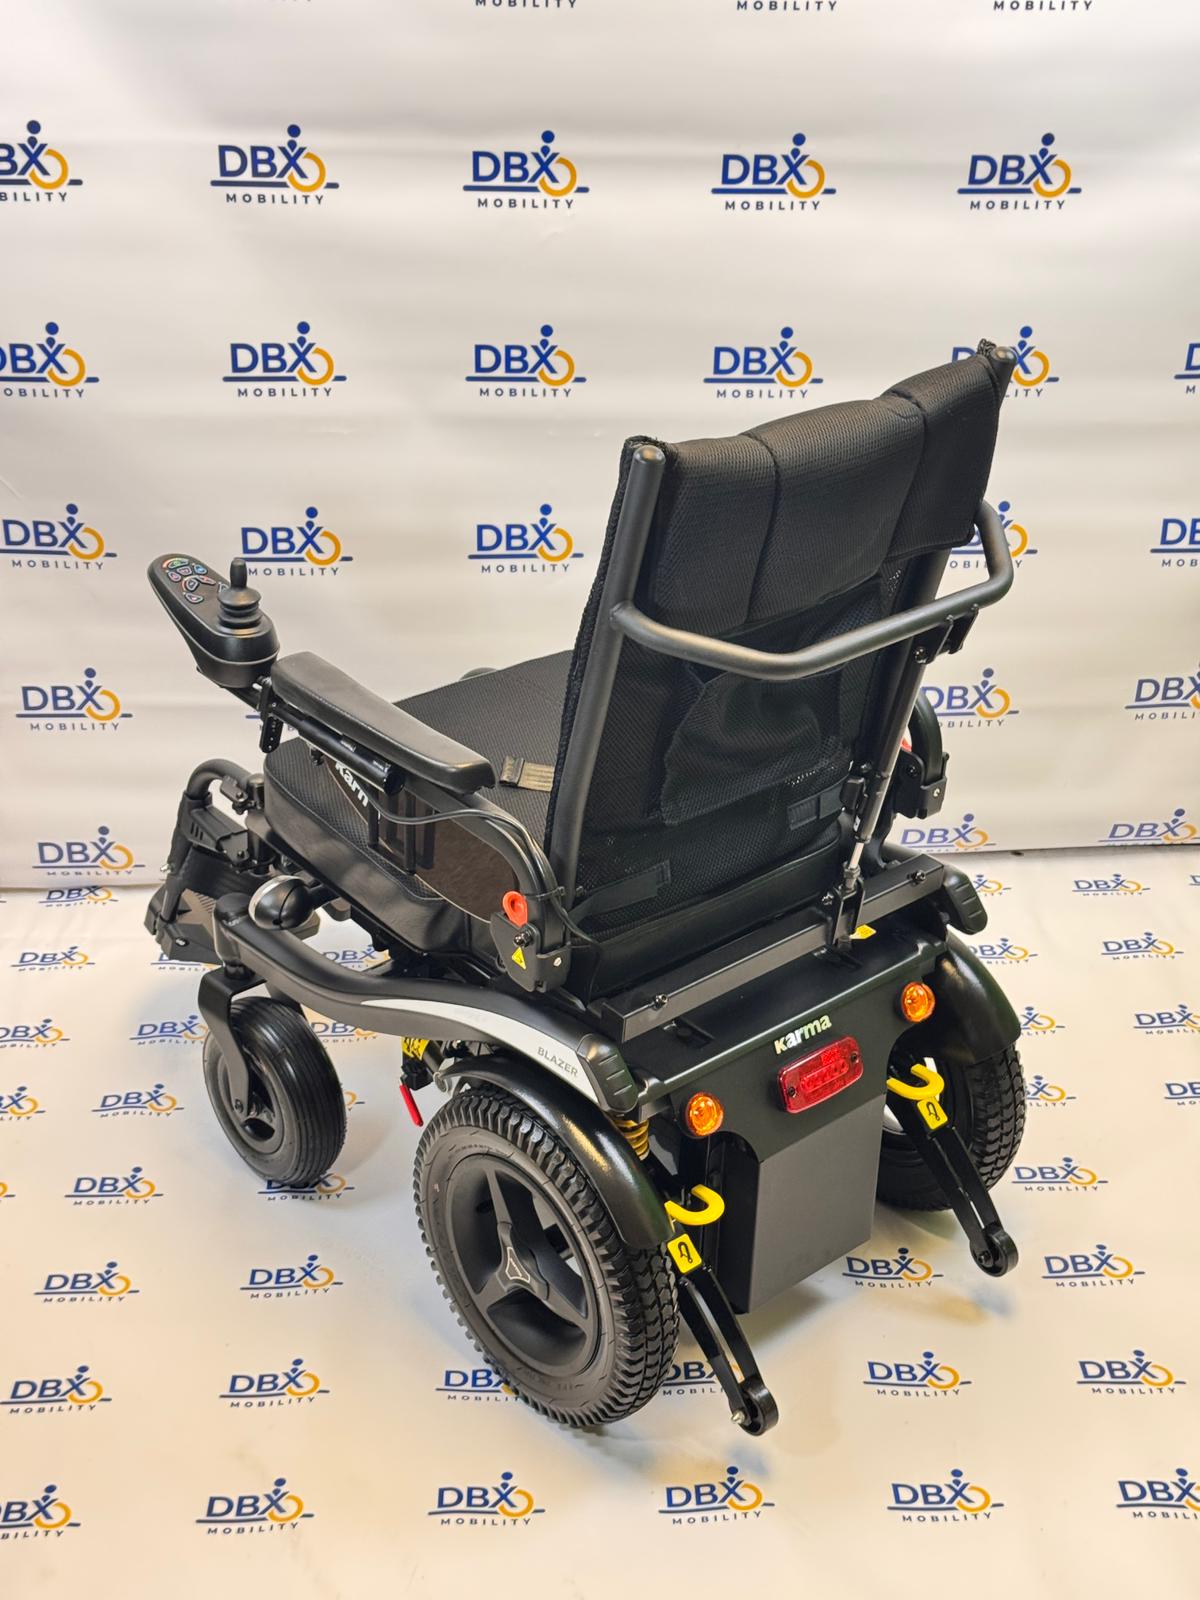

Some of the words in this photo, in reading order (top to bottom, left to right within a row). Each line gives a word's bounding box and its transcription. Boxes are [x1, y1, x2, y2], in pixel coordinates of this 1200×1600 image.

[737, 1, 836, 10] MOBILITY
[994, 0, 1092, 10] MOBILITY
[218, 144, 308, 178] DBX
[472, 151, 560, 183] DBX
[722, 154, 807, 185] DBX
[968, 154, 1057, 185] DBX
[226, 193, 324, 205] MOBILITY
[478, 198, 574, 209] MOBILITY
[725, 200, 820, 211] MOBILITY
[970, 200, 1065, 210] MOBILITY
[0, 343, 68, 374] BX
[230, 342, 317, 374] DBX
[474, 344, 558, 374] DBX
[713, 346, 797, 376] DBX
[238, 387, 332, 398] MOBILITY
[480, 387, 572, 398] MOBILITY
[716, 388, 808, 399] MOBILITY
[2, 519, 87, 548] DBX
[241, 526, 324, 555] DBX
[476, 524, 556, 552] DBX
[12, 559, 104, 570] MOBILITY
[249, 567, 339, 577] MOBILITY
[481, 564, 570, 574] MOBILITY
[22, 684, 102, 711] DBX
[30, 722, 120, 732] MOBILITY
[901, 827, 976, 846] DBX
[1108, 821, 1186, 839] DBX
[38, 841, 117, 864] DBX
[1074, 879, 1130, 890] DBX
[1102, 938, 1162, 952] DBX
[19, 951, 81, 964] DBX
[138, 1021, 200, 1036] DBX
[774, 1014, 832, 1054] karma
[537, 1046, 578, 1078] BLAZER
[100, 1092, 166, 1108] DBX
[1014, 1166, 1084, 1180] DBX
[74, 1176, 144, 1193] DBX
[846, 1256, 916, 1276] DBX
[1044, 1254, 1117, 1274] DBX
[44, 1272, 118, 1290] DBX
[249, 1264, 320, 1285] DBX
[1056, 1278, 1134, 1288] MOBILITY
[854, 1280, 932, 1289] MOBILITY
[250, 1288, 330, 1299] MOBILITY
[868, 1361, 944, 1382] DBX
[1078, 1360, 1158, 1380] DBX
[10, 1378, 91, 1400] DBX
[229, 1369, 306, 1394] DBX
[1092, 1386, 1176, 1394] MOBILITY
[877, 1388, 960, 1397] MOBILITY
[10, 1404, 96, 1414] MOBILITY
[230, 1397, 315, 1408] MOBILITY
[438, 1486, 518, 1508] DBX
[666, 1480, 746, 1508] DBX
[892, 1482, 974, 1506] DBX
[1118, 1480, 1199, 1502] DBX
[206, 1491, 289, 1518] DBX
[441, 1518, 530, 1526] MOBILITY
[672, 1511, 761, 1525] MOBILITY
[902, 1512, 992, 1522] MOBILITY
[208, 1522, 298, 1535] MOBILITY
